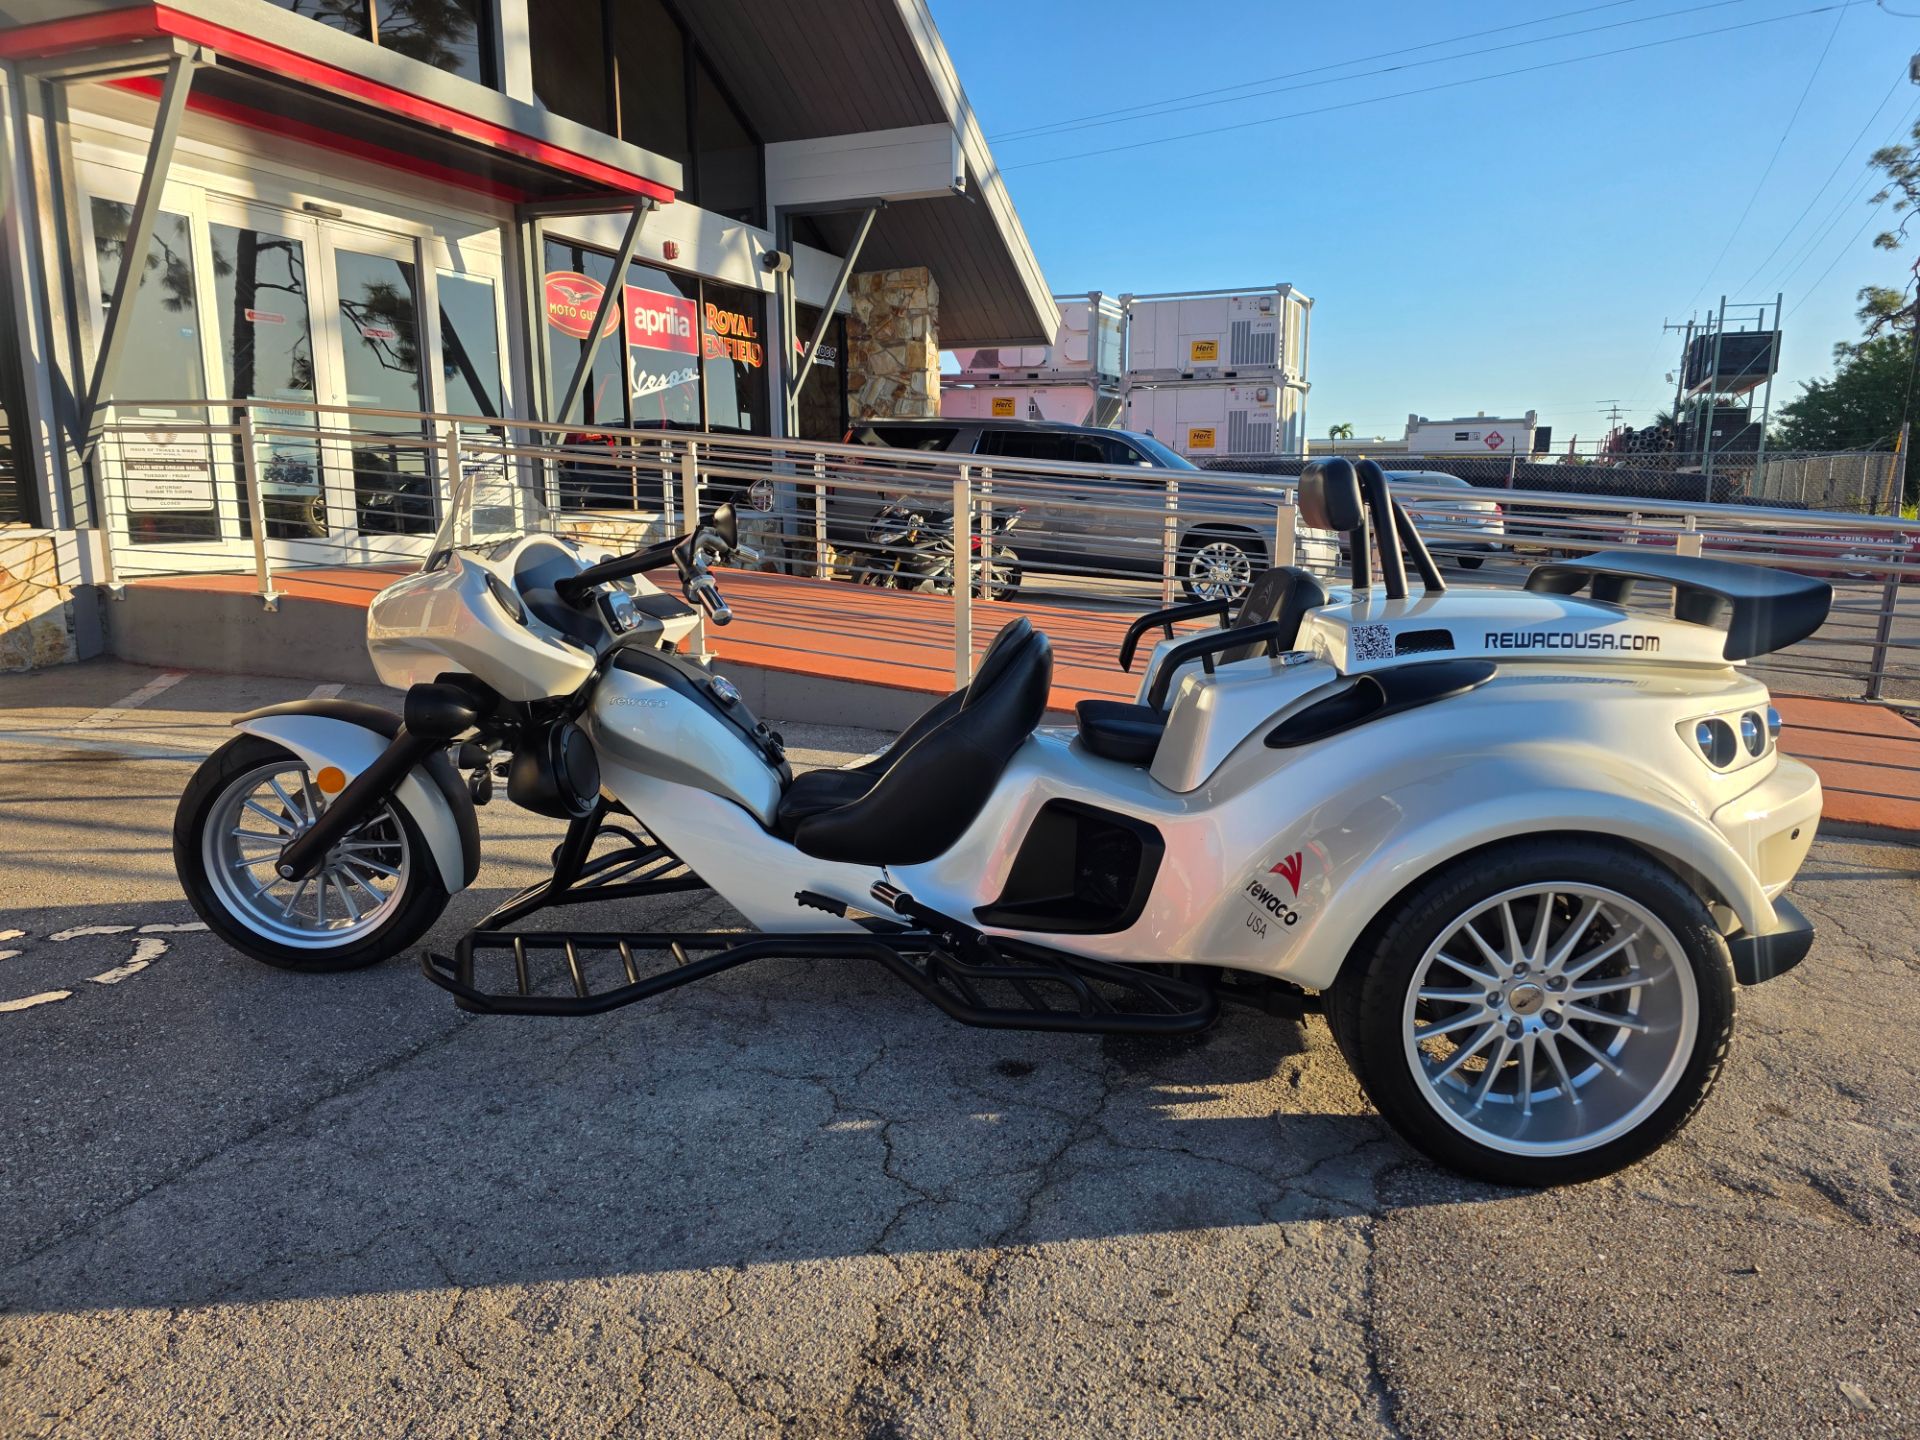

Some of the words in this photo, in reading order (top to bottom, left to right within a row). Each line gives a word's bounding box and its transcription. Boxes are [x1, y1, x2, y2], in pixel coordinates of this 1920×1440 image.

[549, 303, 577, 318] MOTO
[634, 306, 690, 338] aprilia
[705, 302, 757, 338] ROYAL
[703, 333, 764, 368] ENFIELD
[1195, 344, 1215, 352] Herc
[630, 355, 700, 399] Vespa
[1193, 432, 1212, 440] Herc
[1839, 535, 1874, 543] TRIKES
[1245, 879, 1298, 926] rewaco
[1246, 911, 1267, 940] USA
